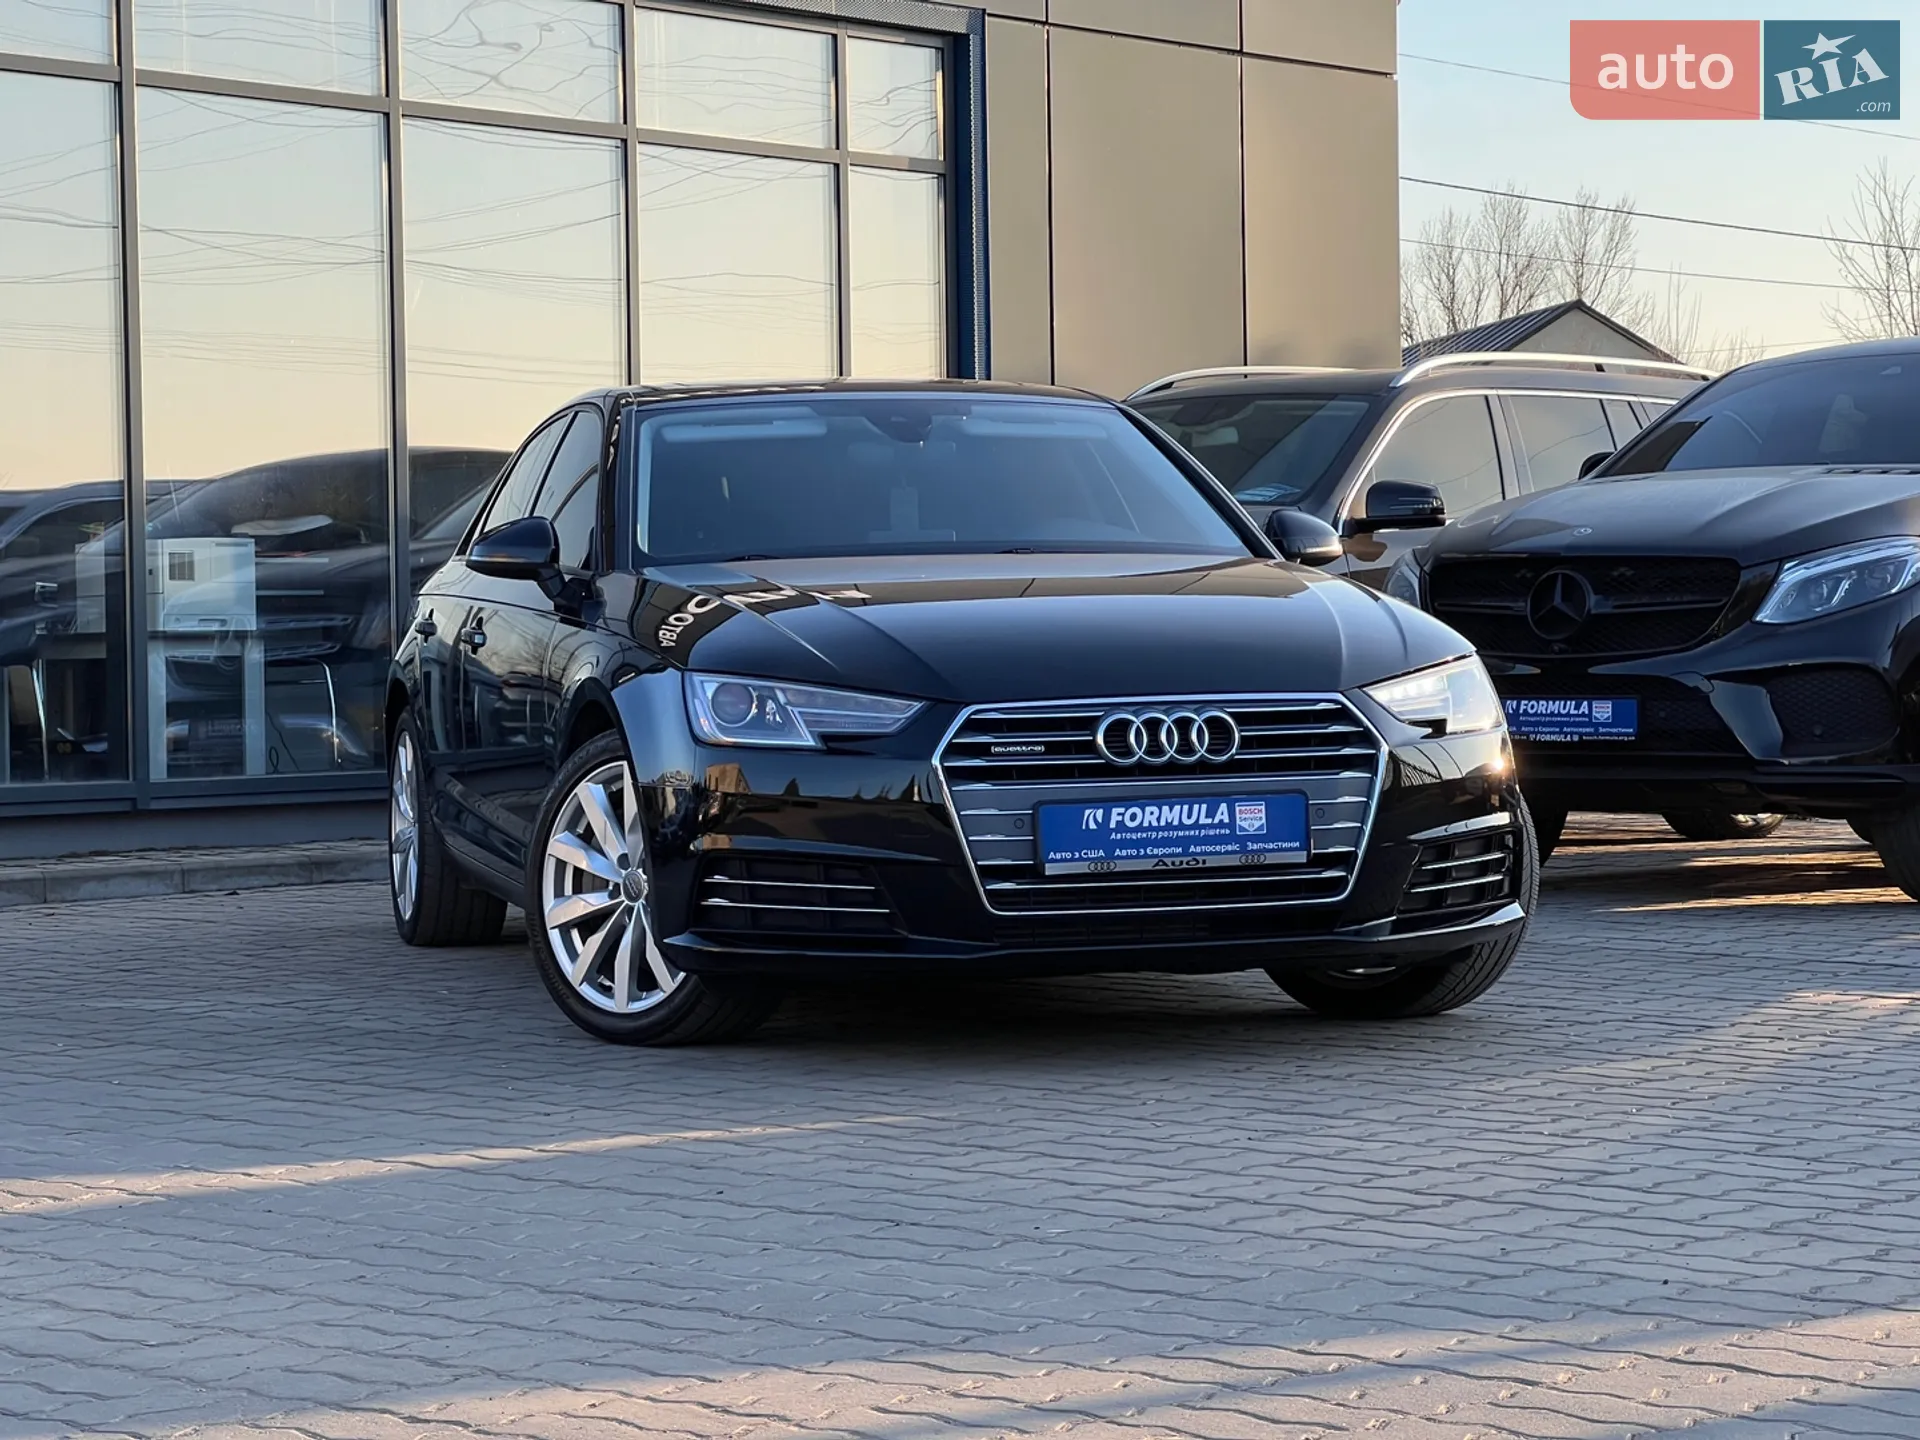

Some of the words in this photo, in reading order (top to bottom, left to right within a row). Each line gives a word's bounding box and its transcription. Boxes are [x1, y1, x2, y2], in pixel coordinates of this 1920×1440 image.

[1519, 700, 1589, 714] FORMULA
[994, 745, 1042, 753] quattro
[1109, 803, 1230, 829] FORMULA
[1238, 807, 1264, 815] BOSCH
[1110, 831, 1157, 840] Автоцентр
[1157, 828, 1199, 840] розумних
[1200, 826, 1231, 837] рішень
[1048, 851, 1072, 860] Авто
[1073, 851, 1080, 859] з
[1081, 849, 1105, 858] США
[1114, 848, 1138, 857] Авто
[1146, 846, 1182, 856] Європи
[1189, 842, 1240, 853] Автосервіс
[1246, 841, 1300, 851] Запчастини
[1152, 857, 1207, 869] Audi
